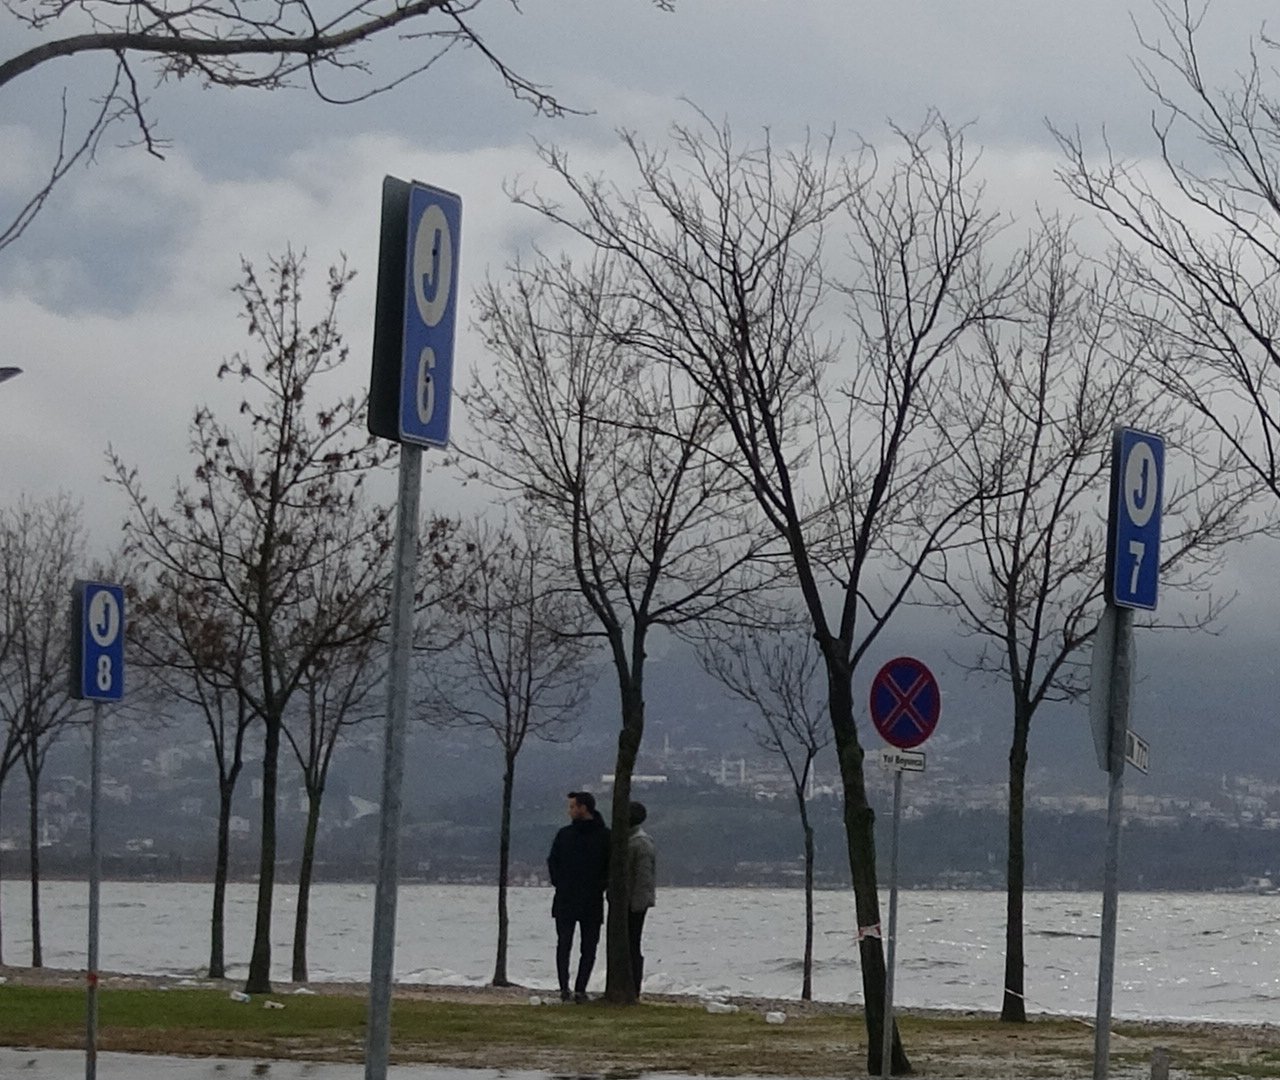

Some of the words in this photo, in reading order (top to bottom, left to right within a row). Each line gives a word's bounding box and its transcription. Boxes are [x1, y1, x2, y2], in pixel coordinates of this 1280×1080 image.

[422, 228, 442, 304] J
[417, 346, 436, 424] 6
[1132, 458, 1149, 510] J
[1129, 540, 1146, 594] 7
[96, 602, 111, 638] J
[97, 654, 112, 692] 8
